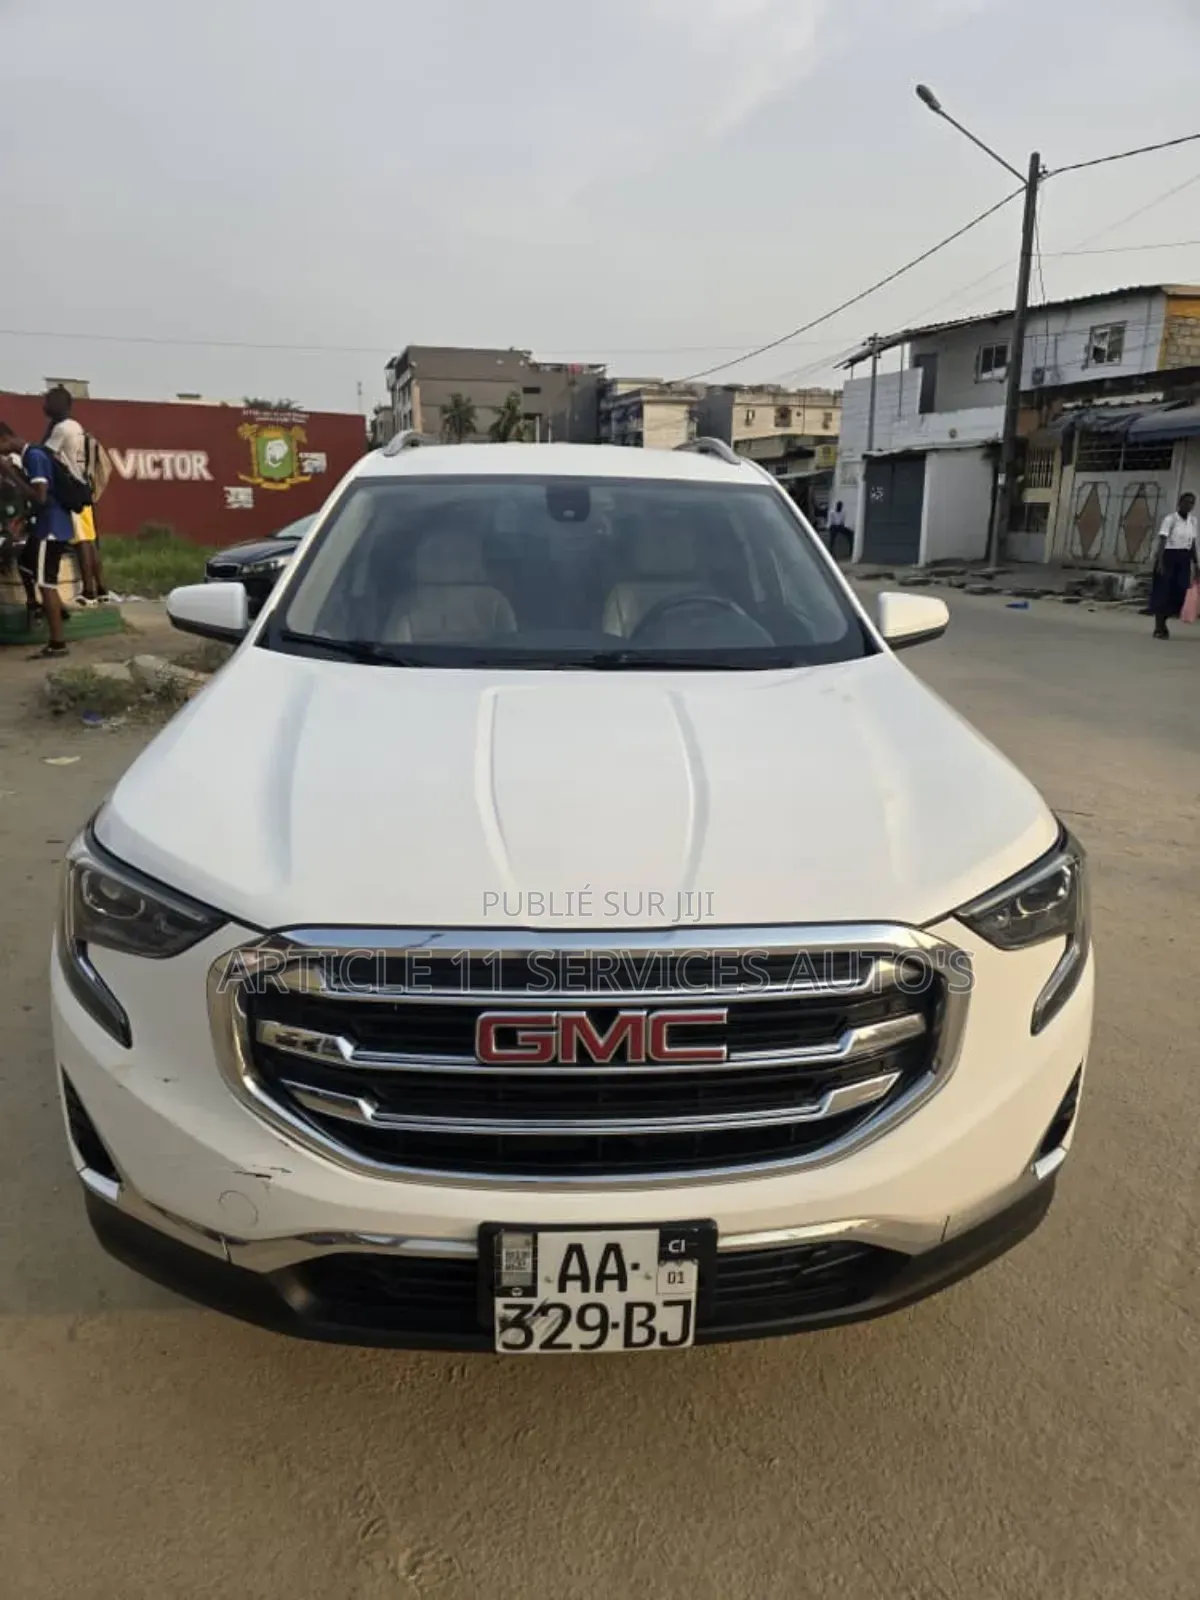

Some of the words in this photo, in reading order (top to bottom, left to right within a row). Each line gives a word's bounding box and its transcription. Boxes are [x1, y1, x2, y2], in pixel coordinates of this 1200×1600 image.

[108, 447, 215, 481] VICTOR
[475, 1007, 729, 1064] GMC
[667, 1238, 686, 1254] CI
[666, 1270, 685, 1285] 01
